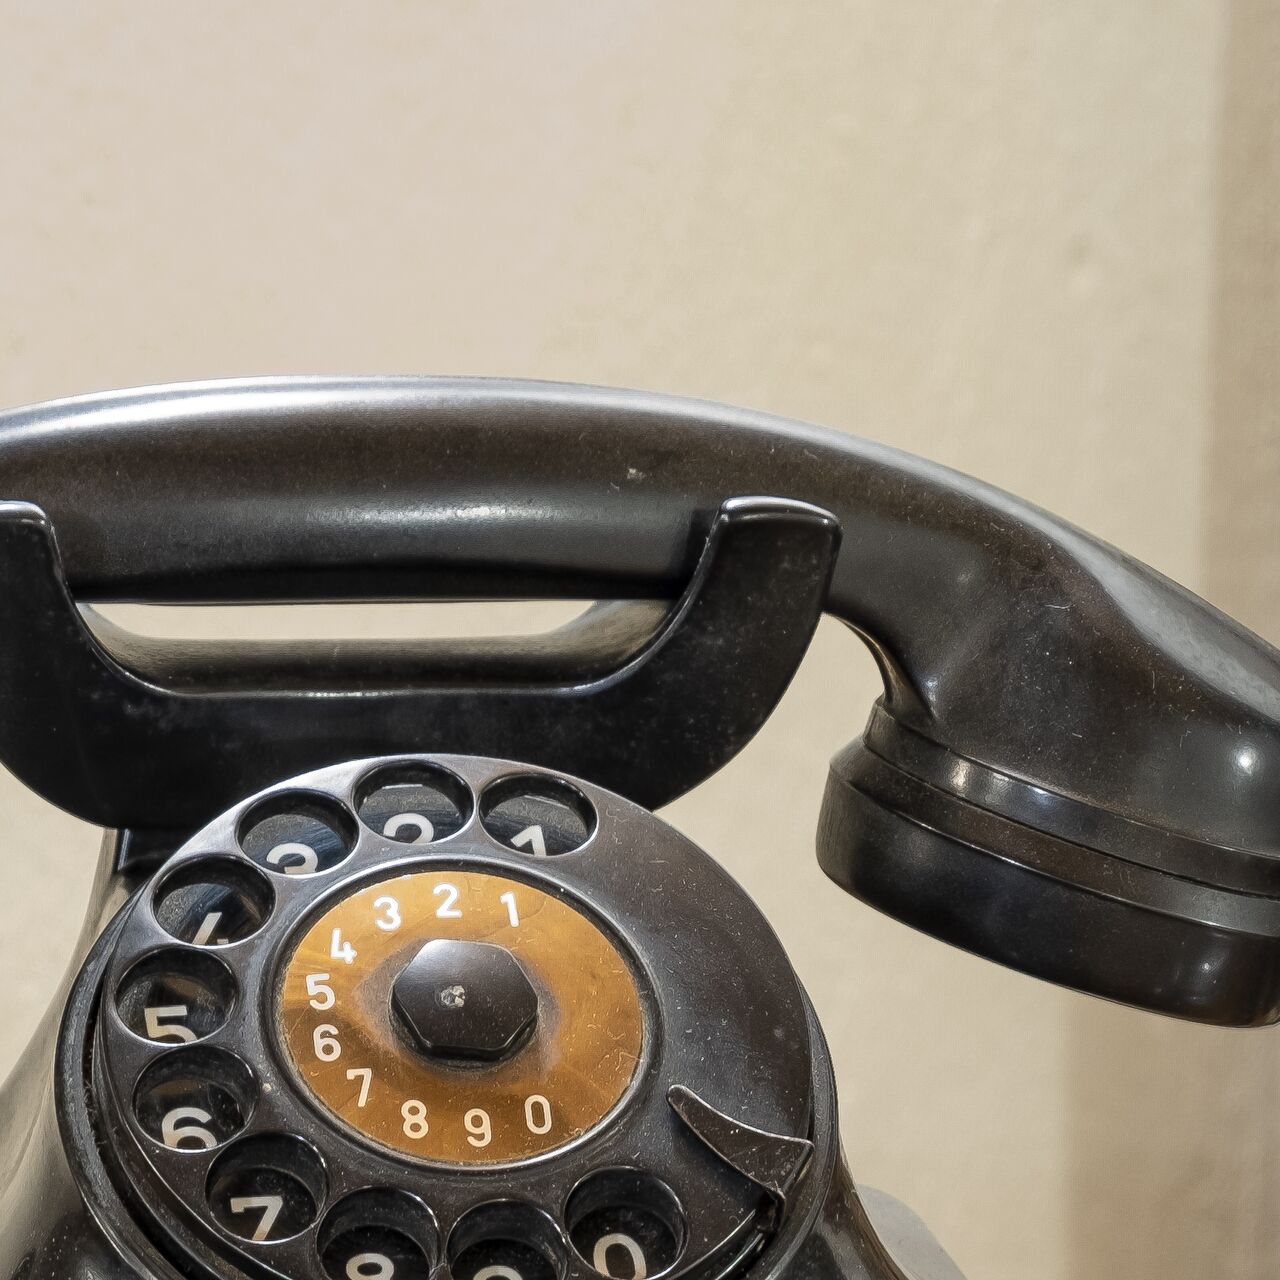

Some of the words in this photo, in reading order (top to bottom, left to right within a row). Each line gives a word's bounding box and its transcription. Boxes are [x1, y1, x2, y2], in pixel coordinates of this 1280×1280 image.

[373, 896, 402, 930] 3
[432, 883, 462, 918] 2
[500, 892, 520, 927] 1
[330, 928, 357, 964] 4
[306, 973, 336, 1010] 5
[313, 1024, 341, 1061] 6
[346, 1068, 372, 1107] 7
[401, 1099, 429, 1139] 8
[463, 1108, 492, 1147] 9
[524, 1094, 552, 1134] 0
[161, 1107, 217, 1149] 6
[230, 1196, 283, 1241] 7
